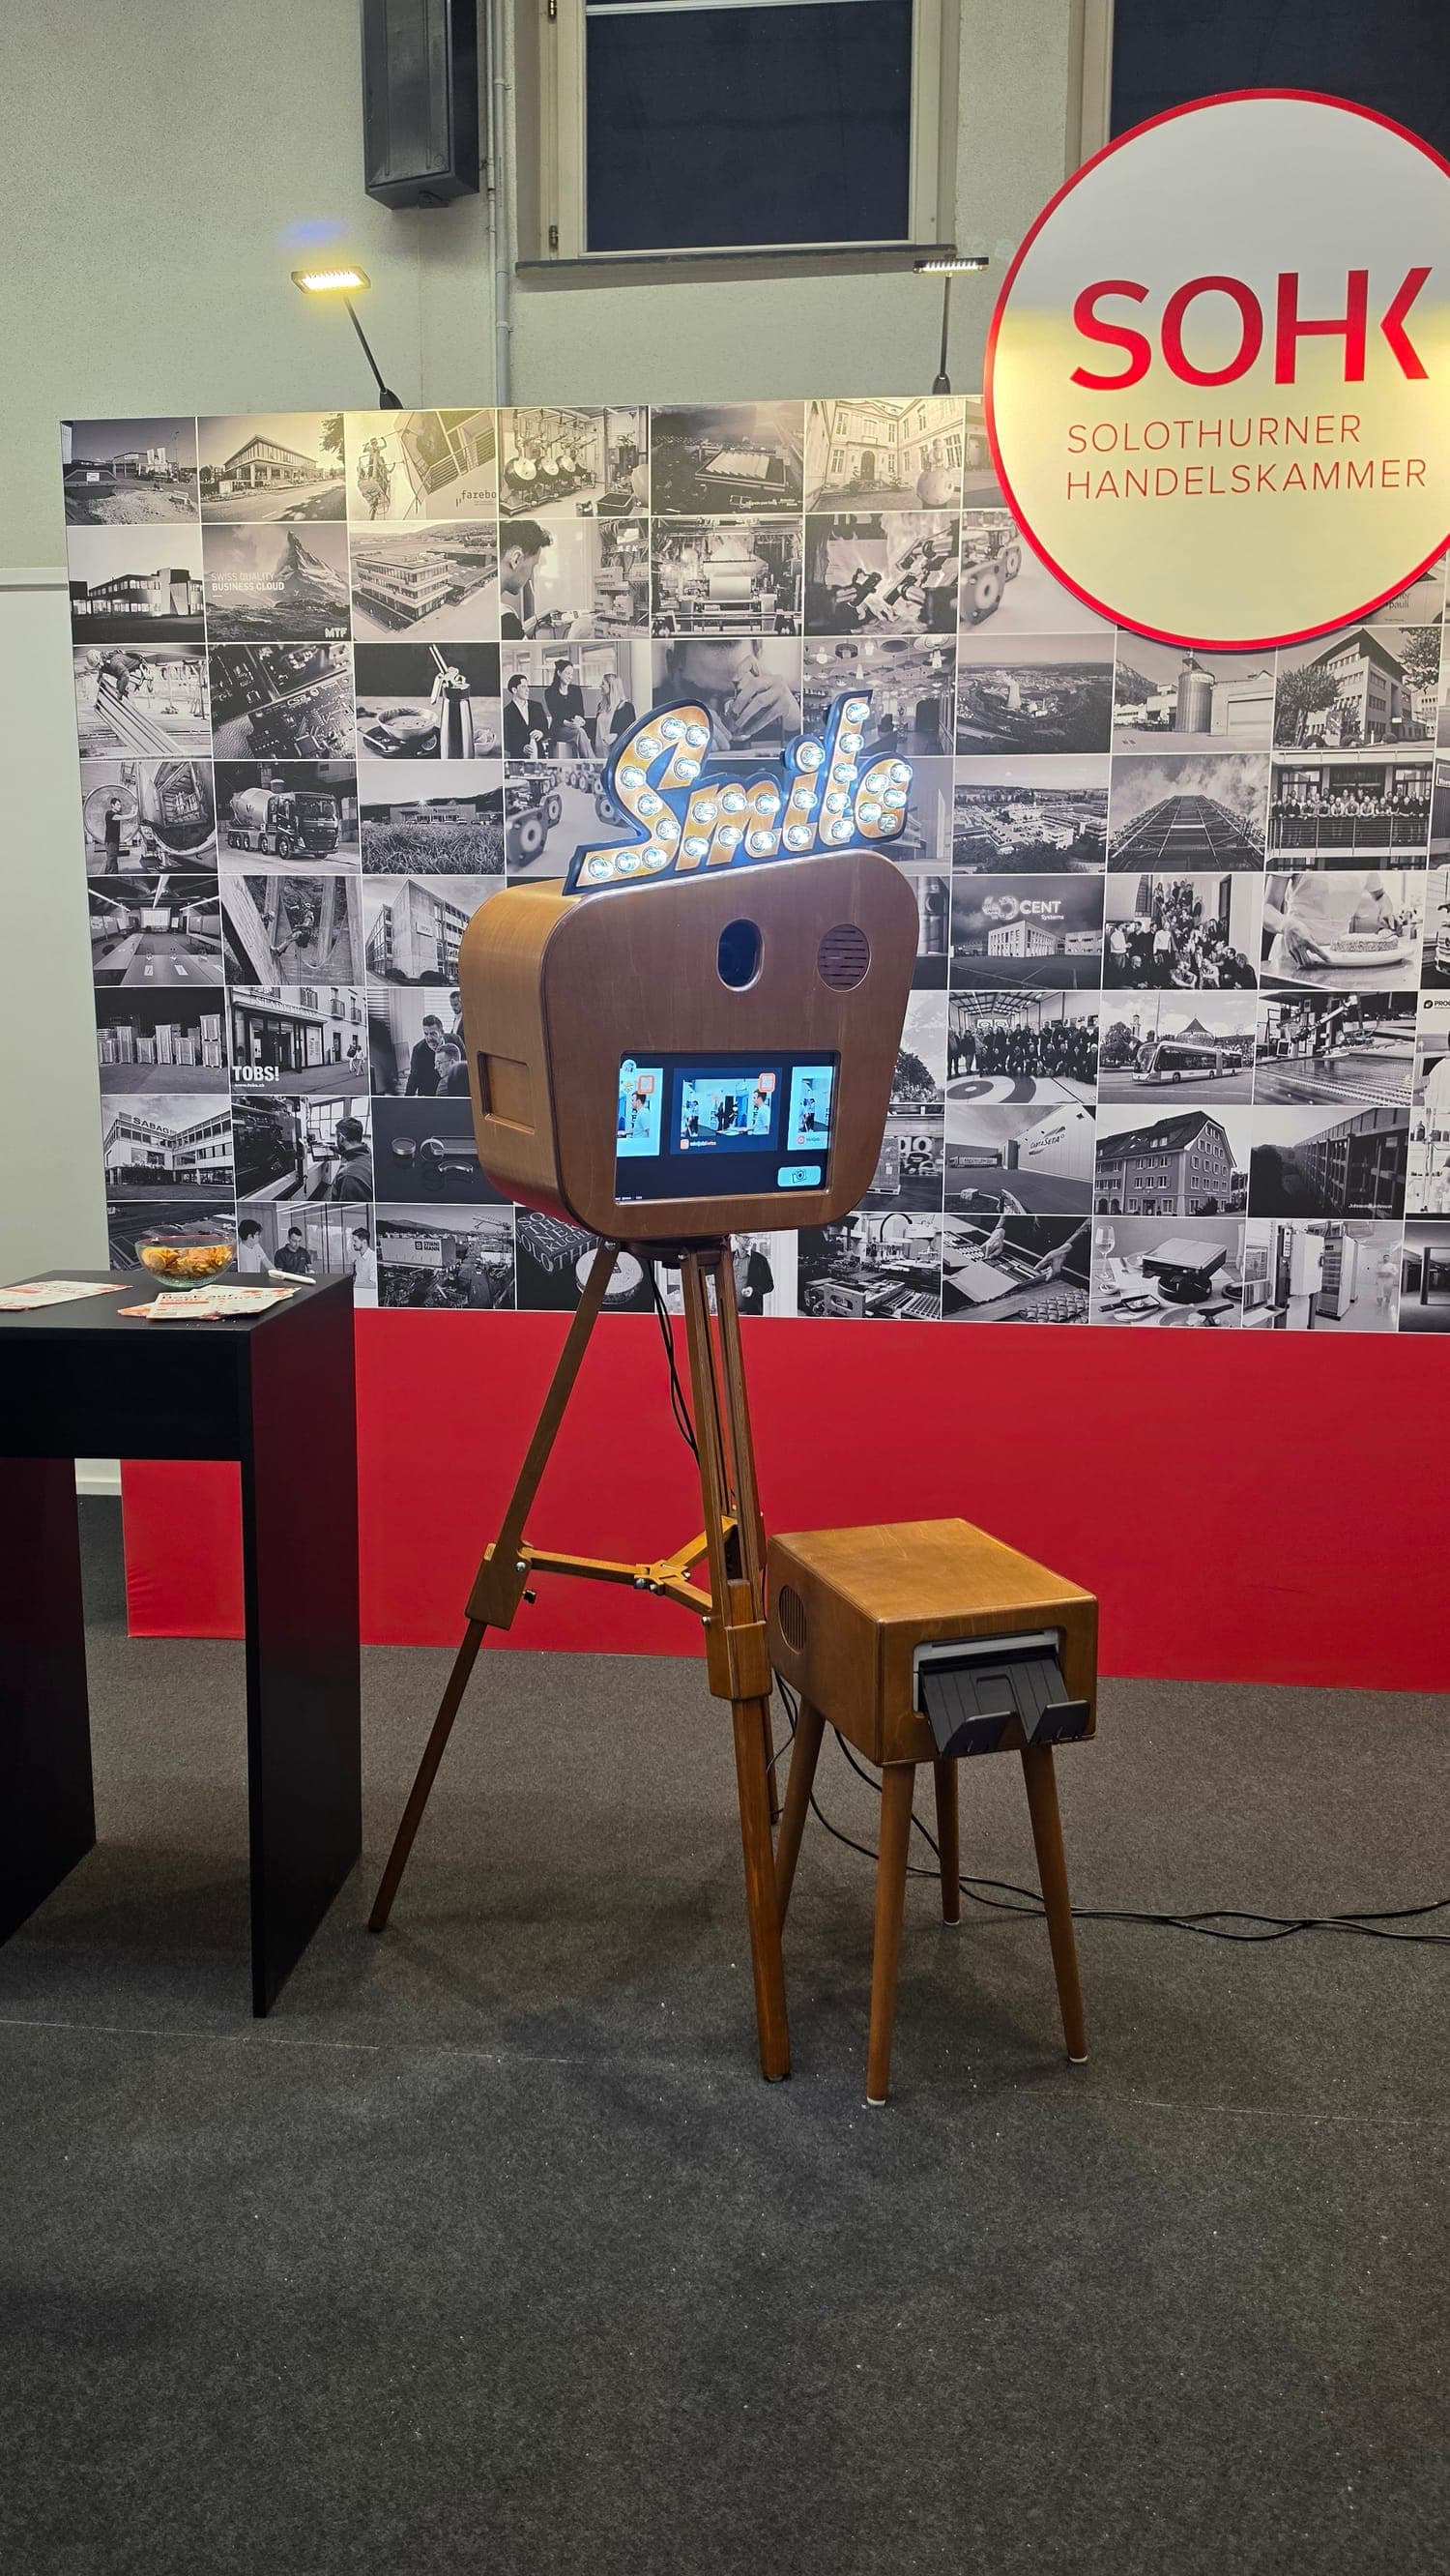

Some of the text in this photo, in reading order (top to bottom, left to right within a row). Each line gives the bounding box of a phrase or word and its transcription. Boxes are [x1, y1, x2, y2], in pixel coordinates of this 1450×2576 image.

[1070, 267, 1433, 391] SOHK
[1066, 414, 1361, 454] SOLOTHURNER
[1066, 458, 1428, 500] HANDELSKAMMER
[239, 572, 274, 581] QUALITY
[256, 582, 284, 591] CLOUD
[324, 628, 347, 638] MTF
[568, 691, 912, 891] Smile
[1020, 900, 1061, 915] CENT
[232, 1066, 279, 1082] TOBS!
[132, 1117, 170, 1134] SABAG
